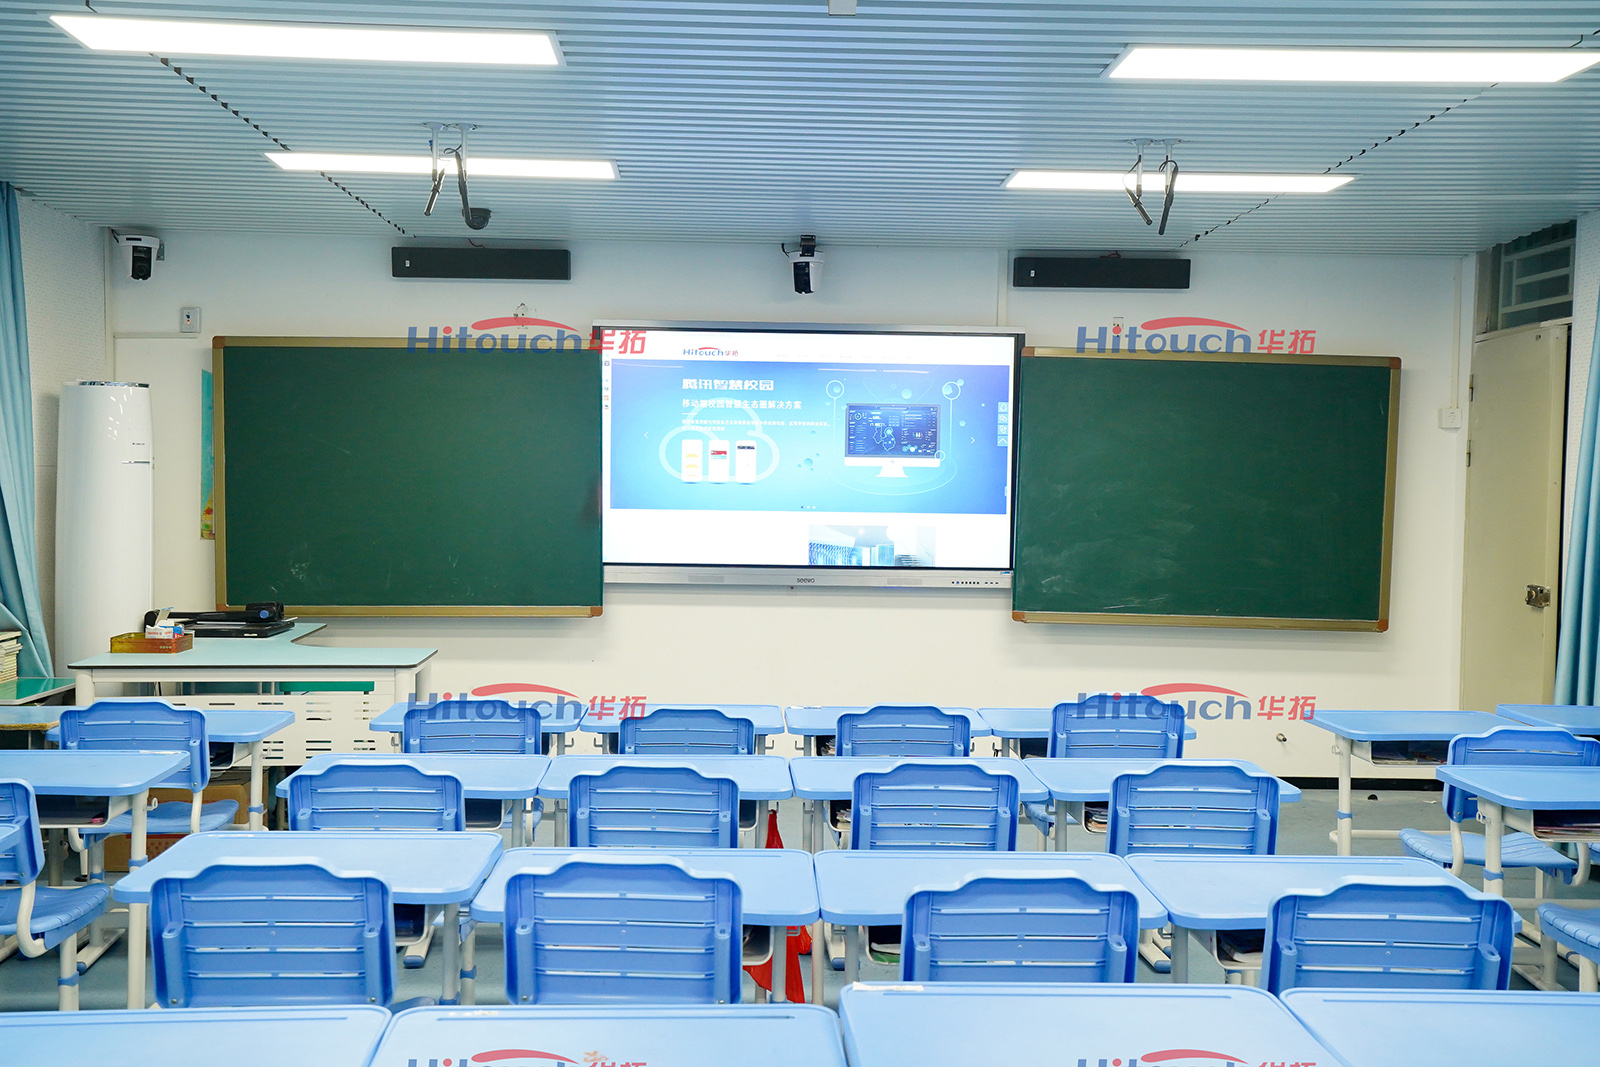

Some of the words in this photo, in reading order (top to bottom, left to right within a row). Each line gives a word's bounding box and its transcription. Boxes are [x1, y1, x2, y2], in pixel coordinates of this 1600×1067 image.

[683, 348, 724, 356] Hitouch
[682, 379, 774, 391] 腾讯智慧校园
